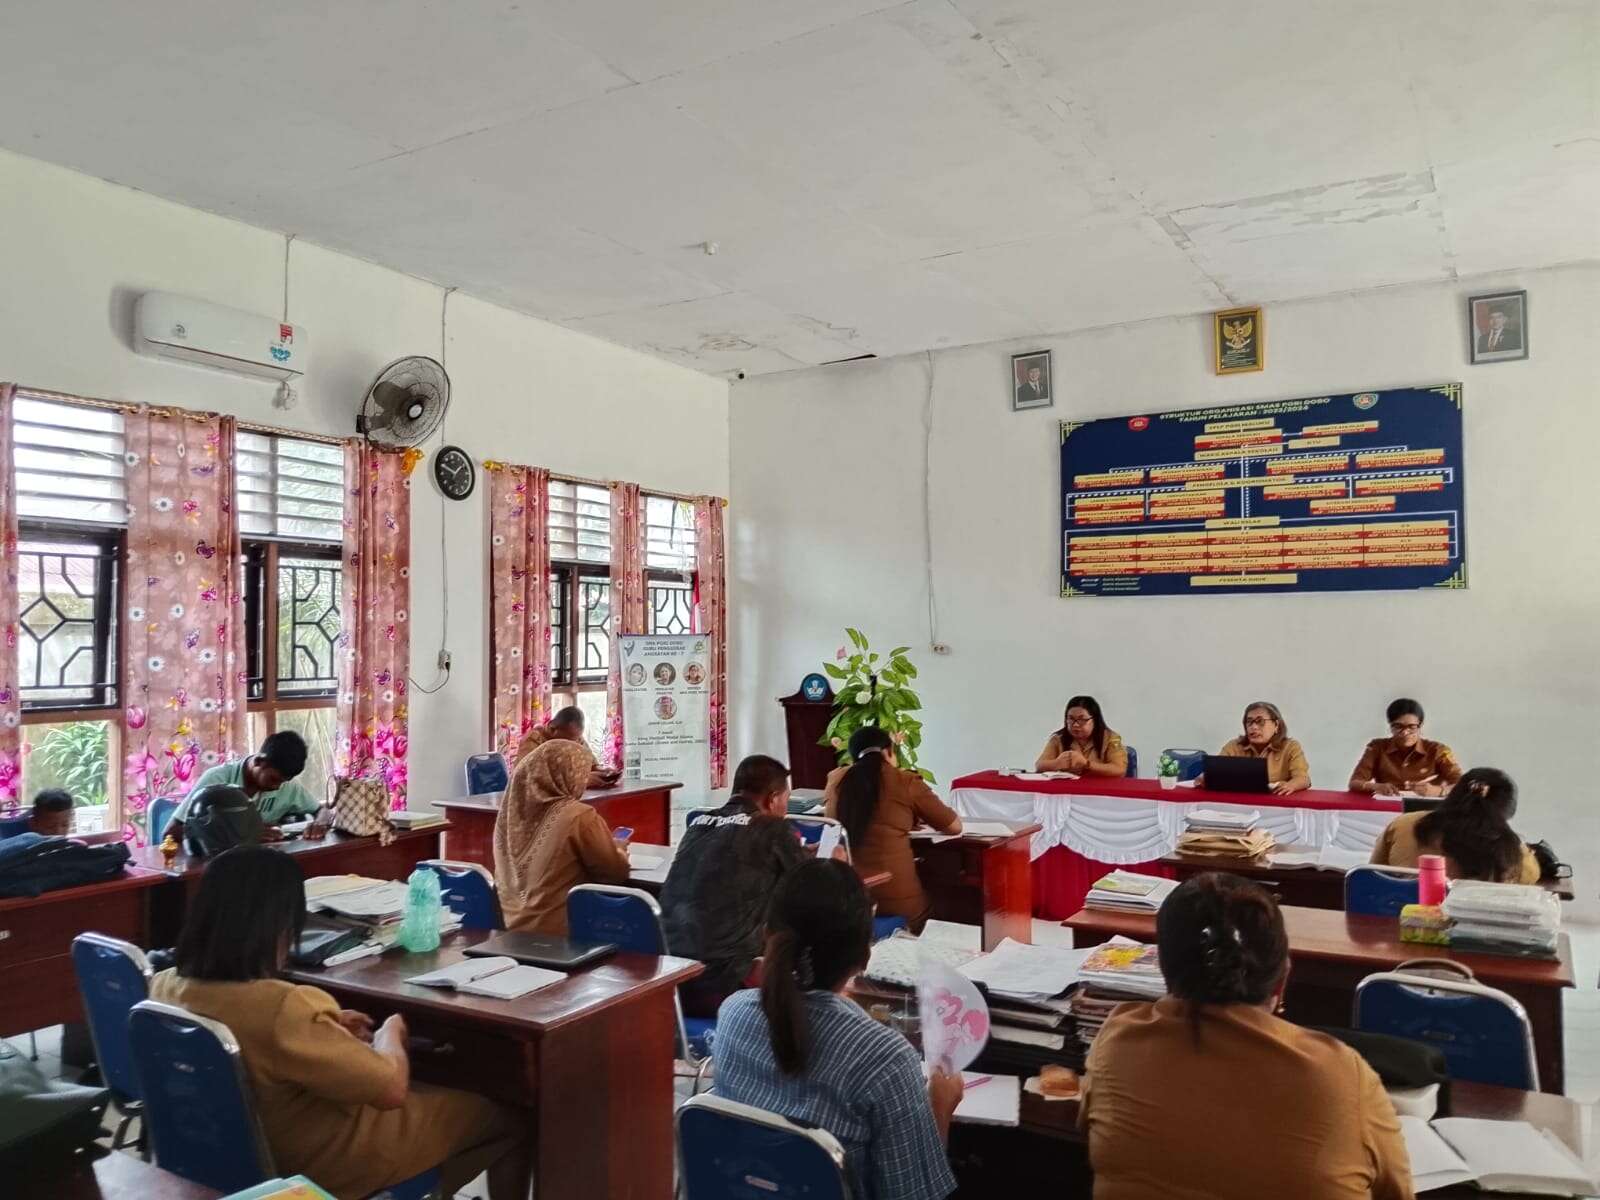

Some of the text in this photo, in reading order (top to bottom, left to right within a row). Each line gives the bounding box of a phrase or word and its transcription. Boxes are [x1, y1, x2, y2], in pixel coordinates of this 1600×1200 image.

[1160, 411, 1201, 420] STRUKTUR
[1202, 405, 1254, 415] ORGANISASI
[1256, 402, 1280, 410] SMAS
[1282, 400, 1302, 408] PGRI
[1179, 414, 1208, 422] TAHUN
[1208, 410, 1257, 419] PELAJARAN
